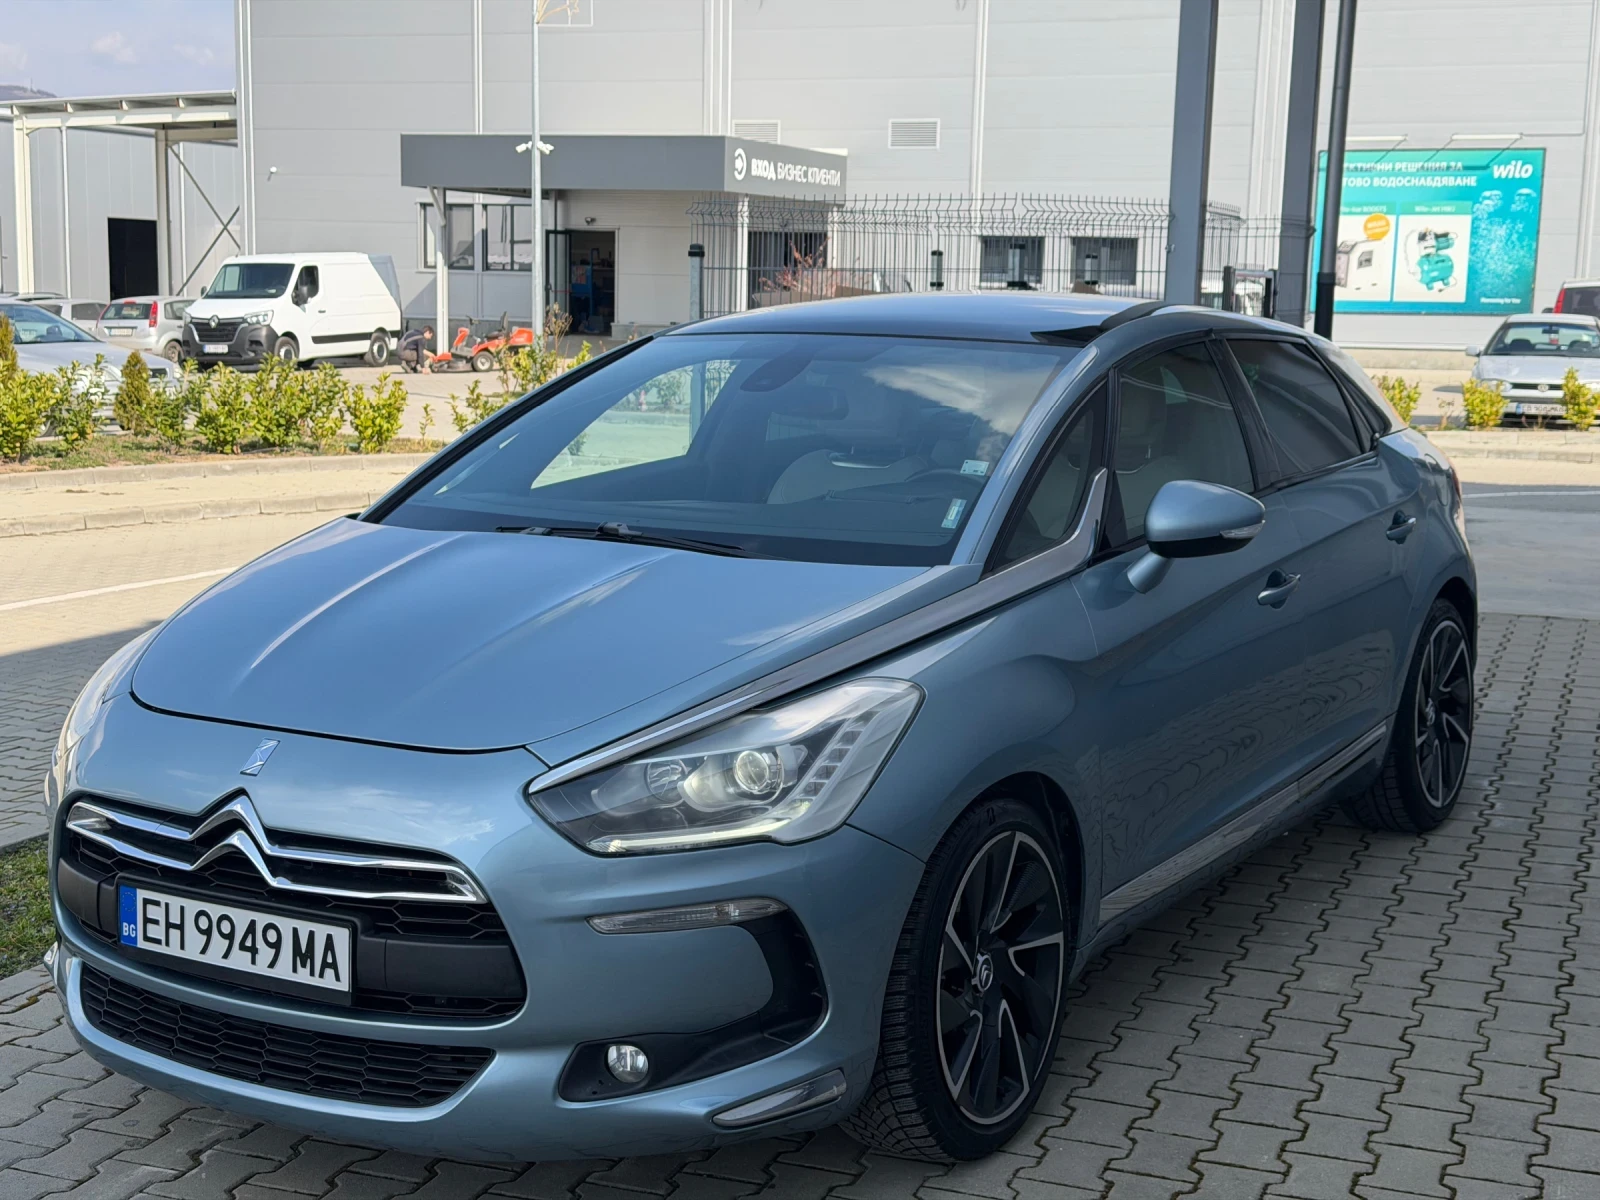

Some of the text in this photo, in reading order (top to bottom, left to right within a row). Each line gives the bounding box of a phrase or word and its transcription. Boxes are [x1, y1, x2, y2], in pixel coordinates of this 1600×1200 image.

[751, 158, 841, 187] ВХОД БИЗНЕС КЛИЕНТИ
[1493, 160, 1533, 179] wilo
[1341, 176, 1478, 188] ТОВО ВОДОСНАБДЯВАНЕ
[122, 922, 136, 938] BG
[142, 897, 342, 983] EH 9949 MA
